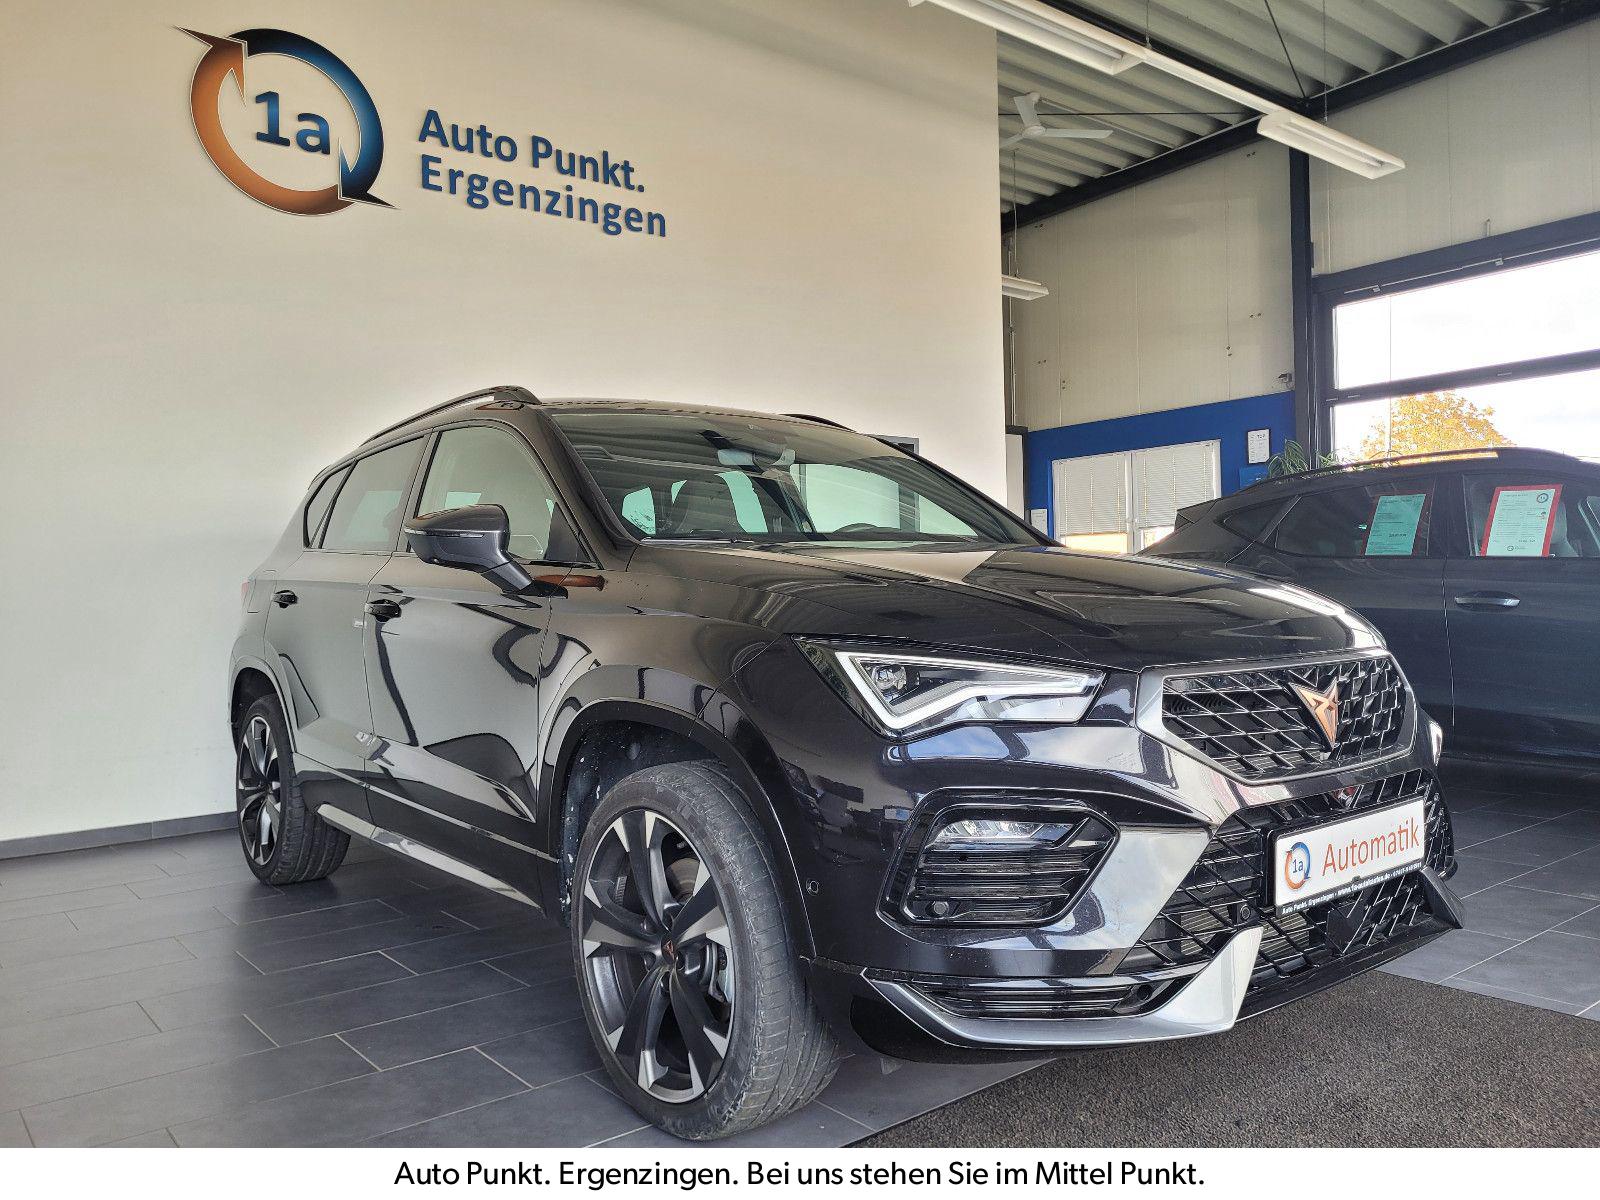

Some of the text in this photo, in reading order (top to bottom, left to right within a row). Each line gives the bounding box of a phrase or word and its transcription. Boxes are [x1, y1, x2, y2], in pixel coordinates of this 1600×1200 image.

[255, 90, 331, 155] 1a
[418, 109, 645, 193] Auto Punkt.
[421, 153, 667, 237] Ergenzingen
[1292, 858, 1304, 874] 1a
[1322, 816, 1420, 877] Automatik
